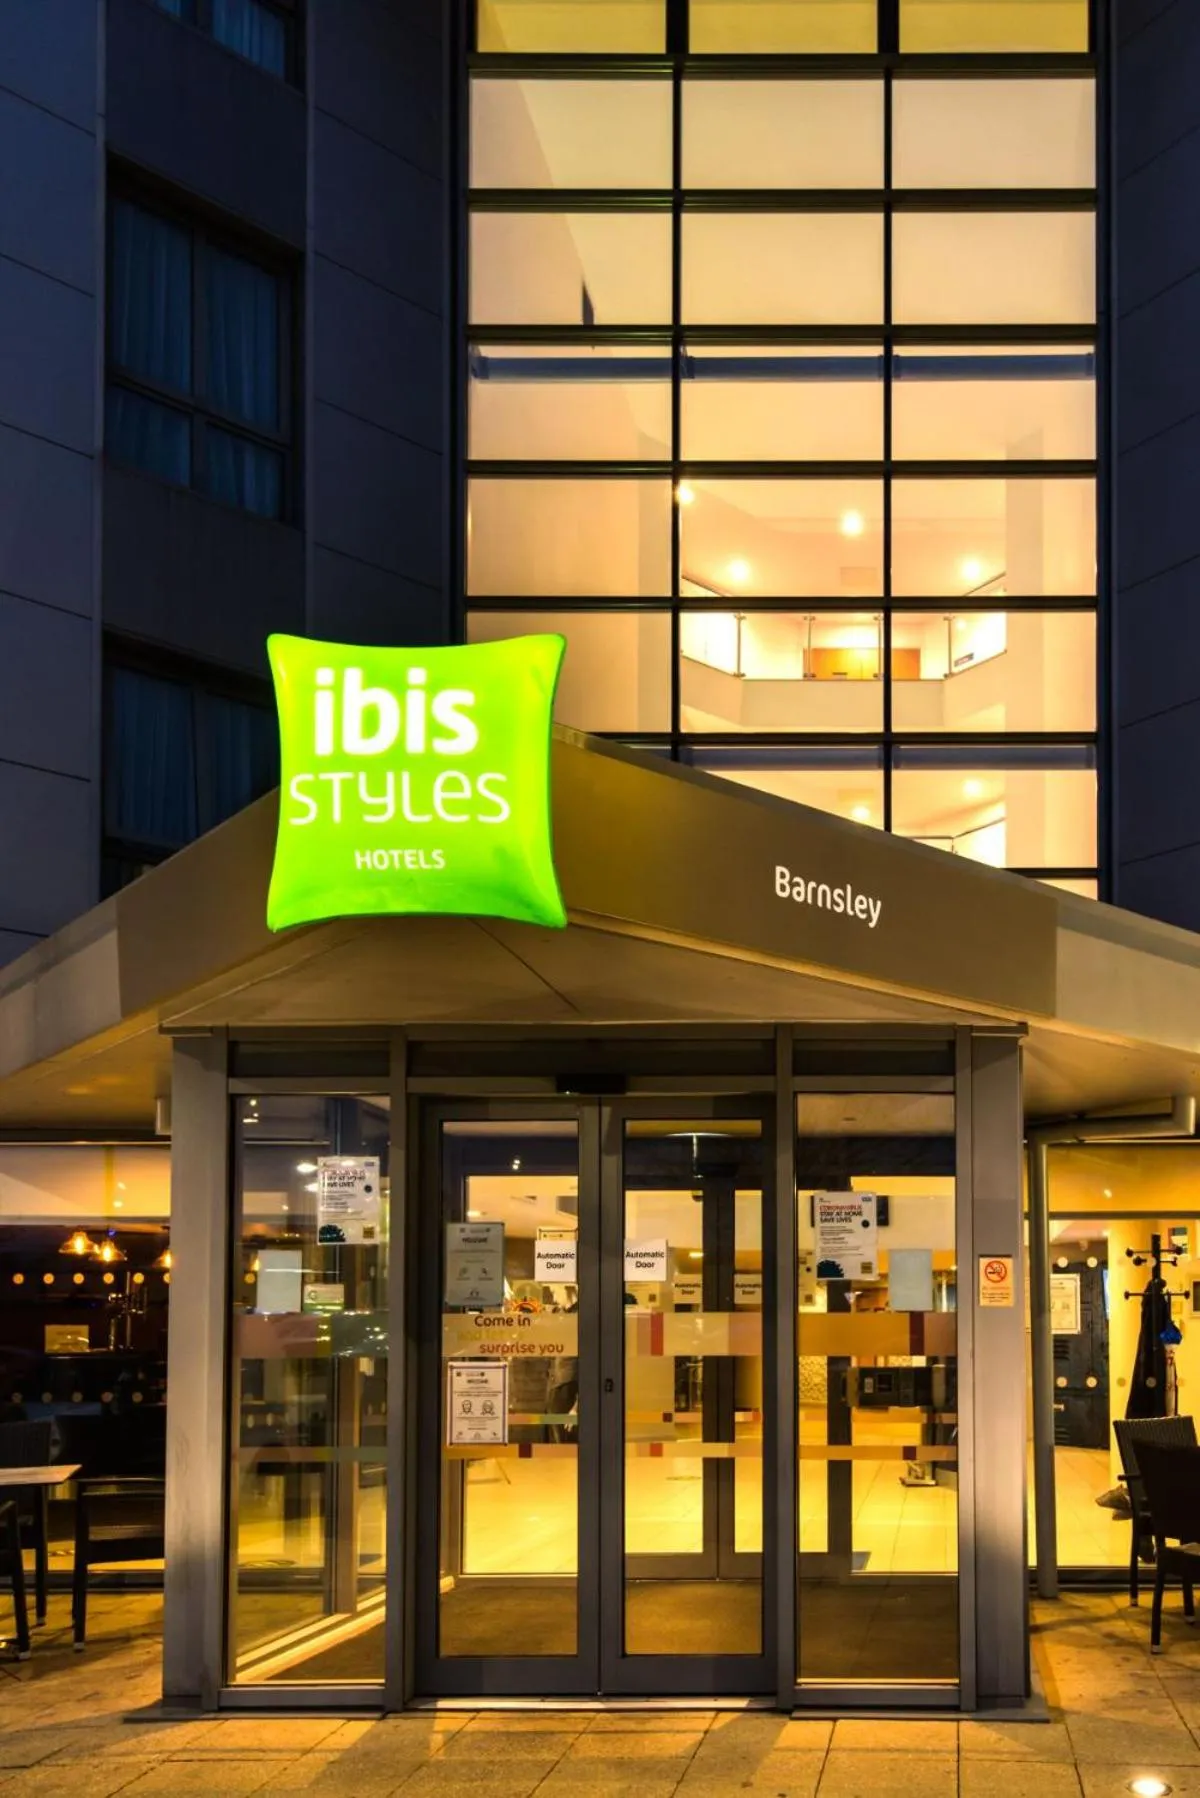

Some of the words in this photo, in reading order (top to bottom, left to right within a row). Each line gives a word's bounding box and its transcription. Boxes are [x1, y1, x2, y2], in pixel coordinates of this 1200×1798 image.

[314, 667, 479, 757] ibis
[354, 849, 446, 870] HOTELS
[775, 865, 882, 928] Barnsley
[536, 1251, 575, 1259] Automatic
[625, 1250, 665, 1258] Automatic
[546, 1262, 565, 1270] Door
[635, 1260, 655, 1268] Door
[474, 1315, 514, 1327] Come
[517, 1314, 531, 1327] in
[479, 1341, 536, 1355] surprise
[539, 1343, 565, 1355] you
